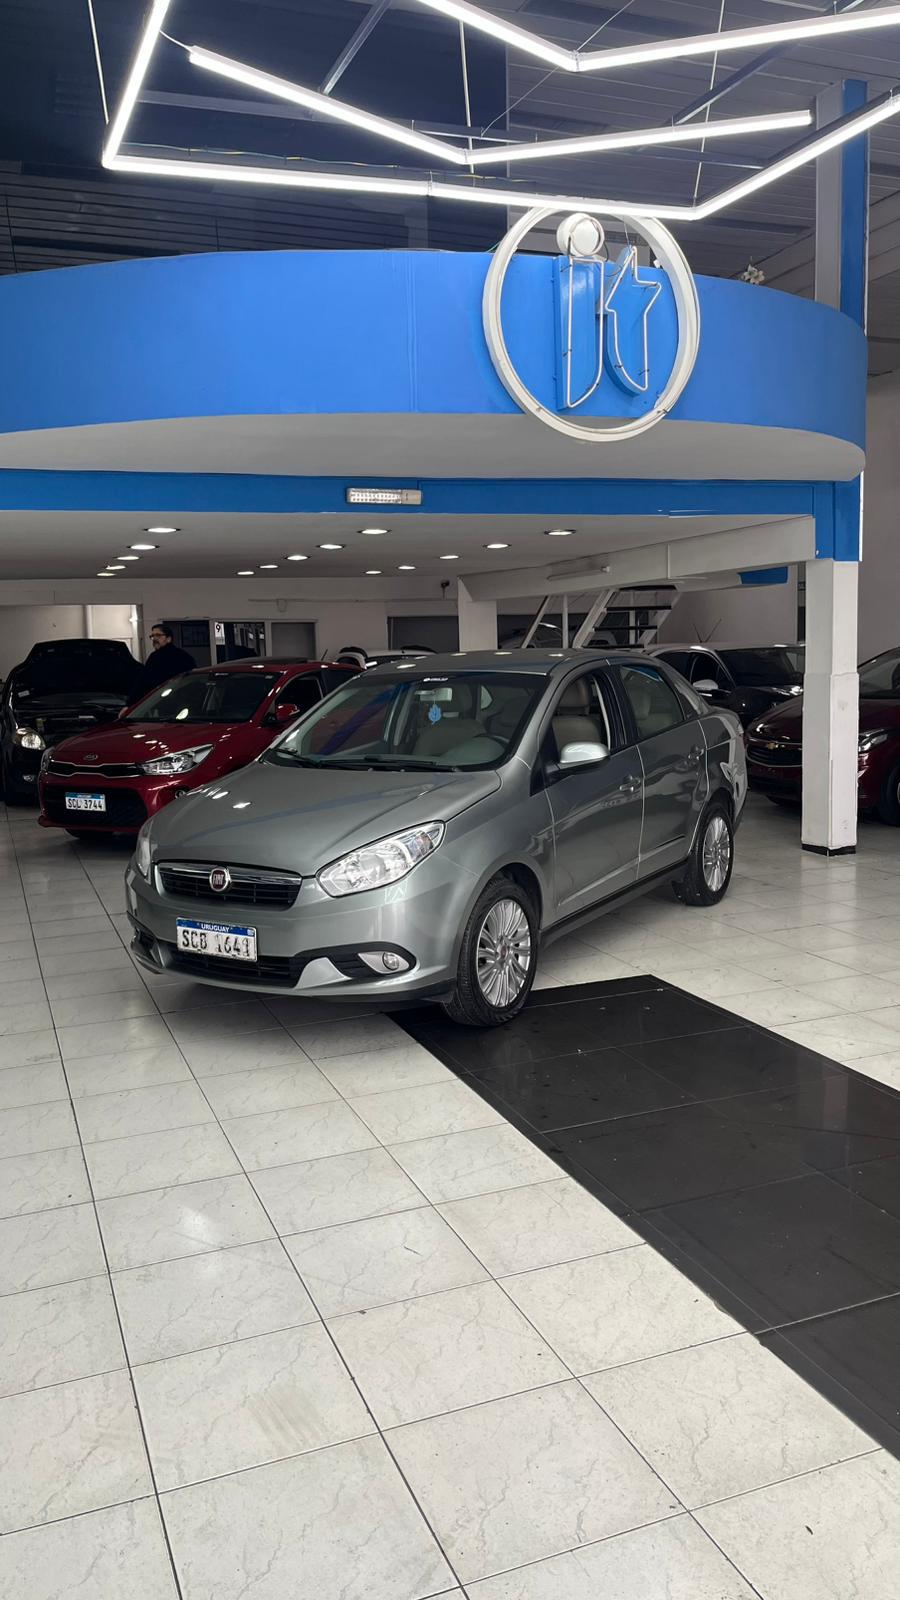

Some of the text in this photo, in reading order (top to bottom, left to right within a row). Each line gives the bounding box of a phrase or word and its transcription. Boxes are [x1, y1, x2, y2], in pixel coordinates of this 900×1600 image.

[84, 799, 103, 810] 3744
[201, 923, 230, 933] URUGUAY
[215, 933, 250, 957] 1641
